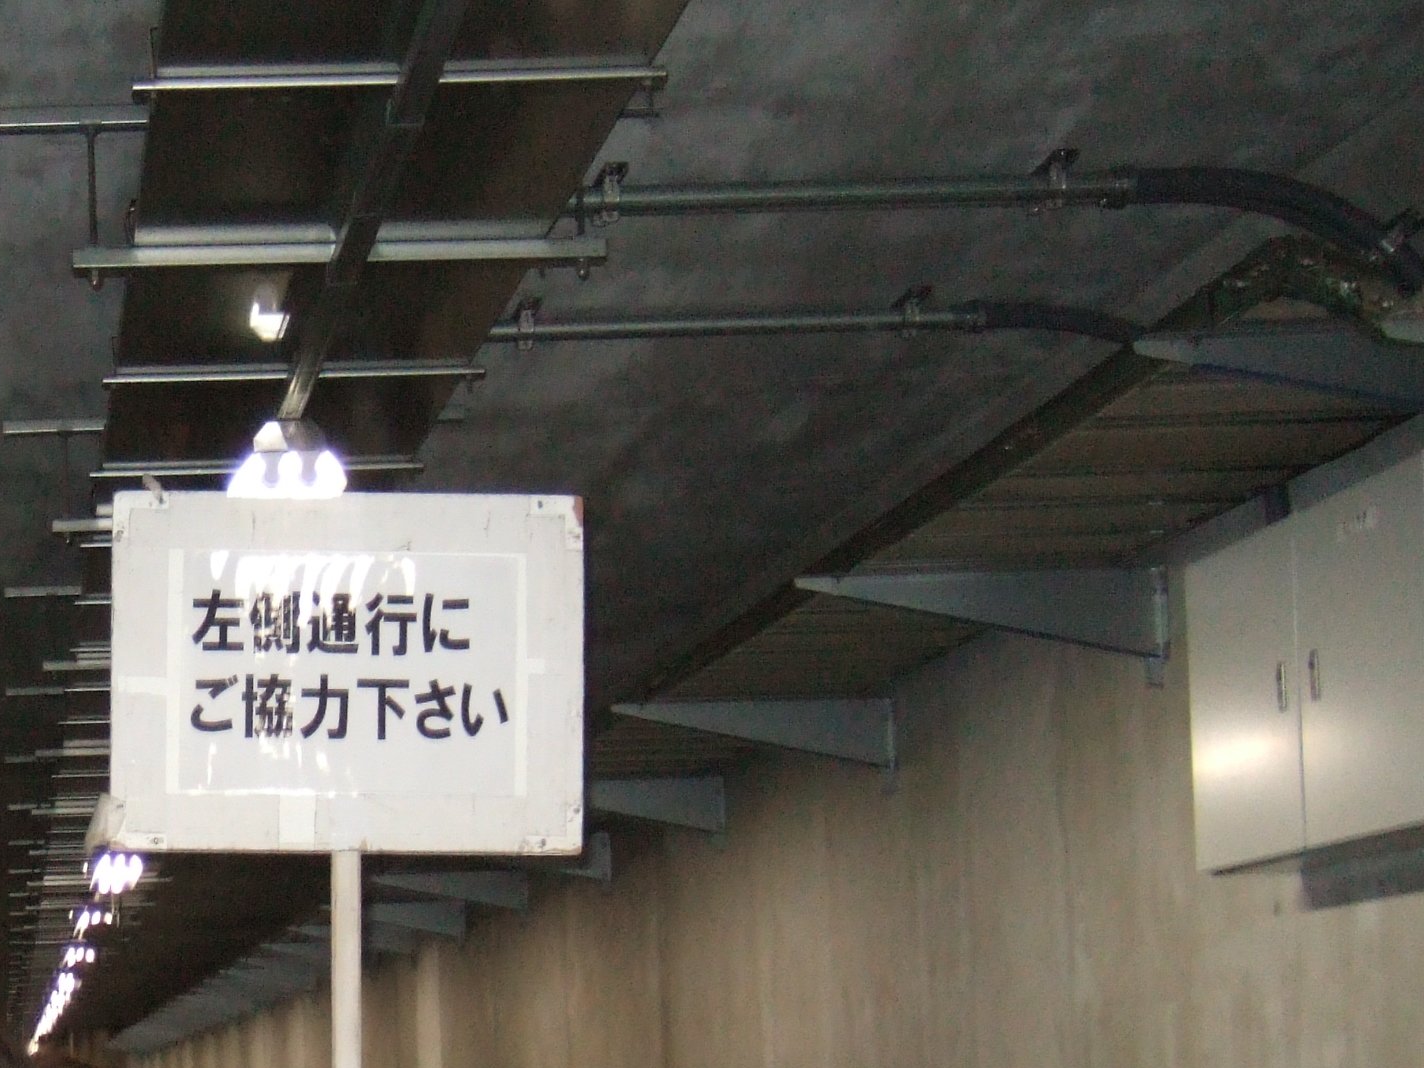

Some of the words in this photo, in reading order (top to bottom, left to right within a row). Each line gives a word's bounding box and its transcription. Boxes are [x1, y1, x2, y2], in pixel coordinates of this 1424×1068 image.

[192, 588, 471, 656] 左側通行に
[190, 673, 509, 740] ご協力下さい
